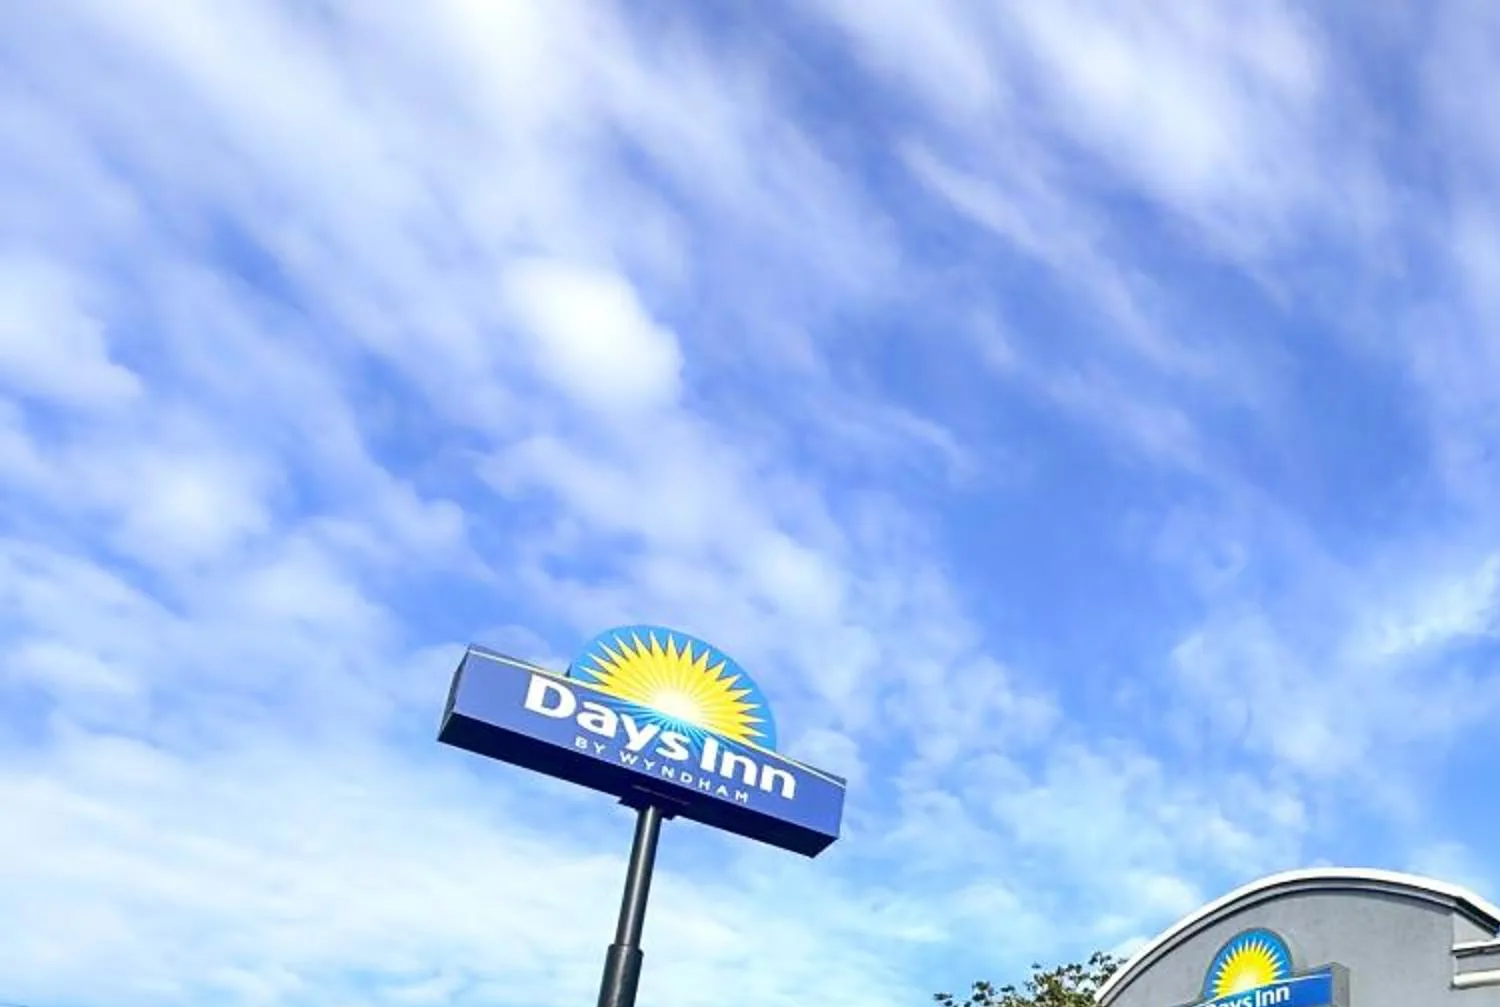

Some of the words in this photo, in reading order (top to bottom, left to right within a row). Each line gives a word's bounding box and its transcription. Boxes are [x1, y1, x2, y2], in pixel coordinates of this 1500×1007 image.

[524, 674, 690, 761] Days
[701, 737, 796, 800] Inn
[575, 735, 605, 754] BY
[619, 750, 748, 803] WYNDHAM
[1255, 986, 1290, 1007] Inn
